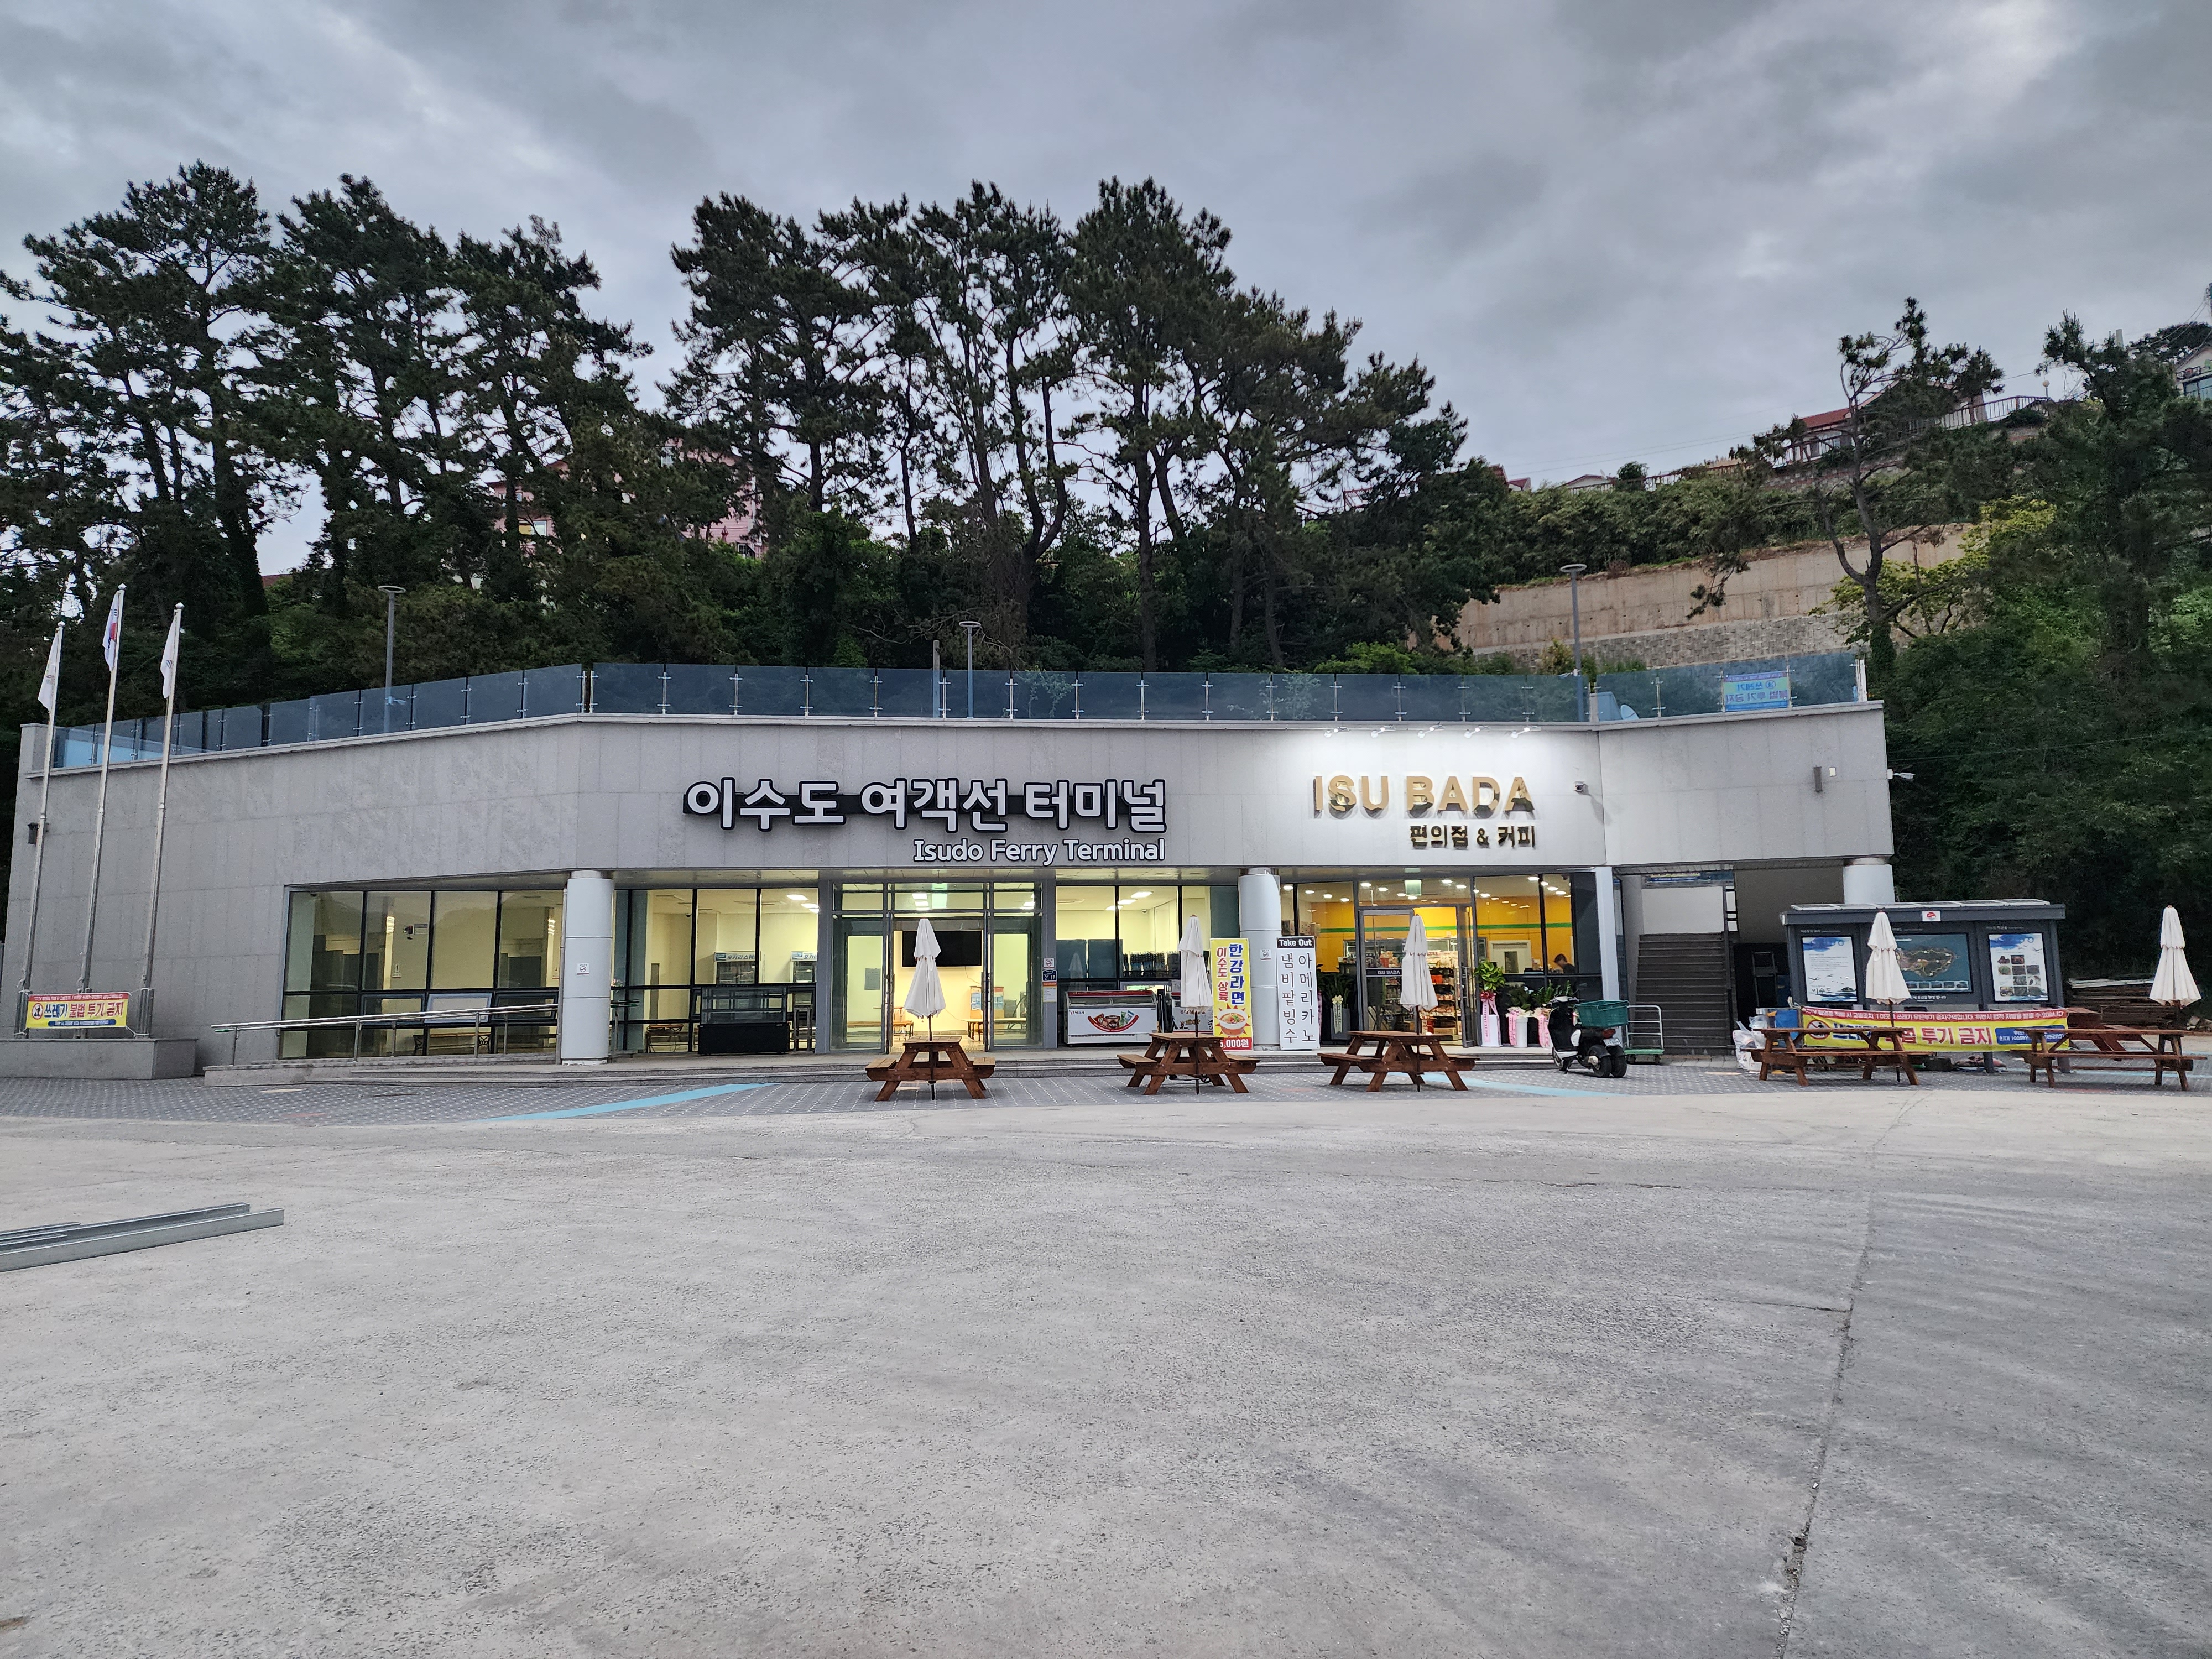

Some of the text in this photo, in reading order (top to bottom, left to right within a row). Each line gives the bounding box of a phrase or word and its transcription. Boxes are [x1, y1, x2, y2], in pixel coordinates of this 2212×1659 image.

[685, 777, 1167, 833] 이수도 여객선 터미널
[1313, 775, 1534, 816] ISU BADA
[914, 838, 1166, 866] Isudo Ferry Terminal
[1410, 825, 1536, 848] 편의점 & 커피
[1279, 937, 1312, 947] Take Out
[1217, 947, 1228, 978] 이수도
[1229, 943, 1245, 1005] 한강라면
[44, 1002, 124, 1018] 쓰레기 불법 투기 금지
[1280, 952, 1298, 1044] 냄비팥빙수
[1298, 952, 1316, 1042] 아메리카노
[1922, 1027, 1954, 1045] 투기
[1958, 1027, 1992, 1045] 금지
